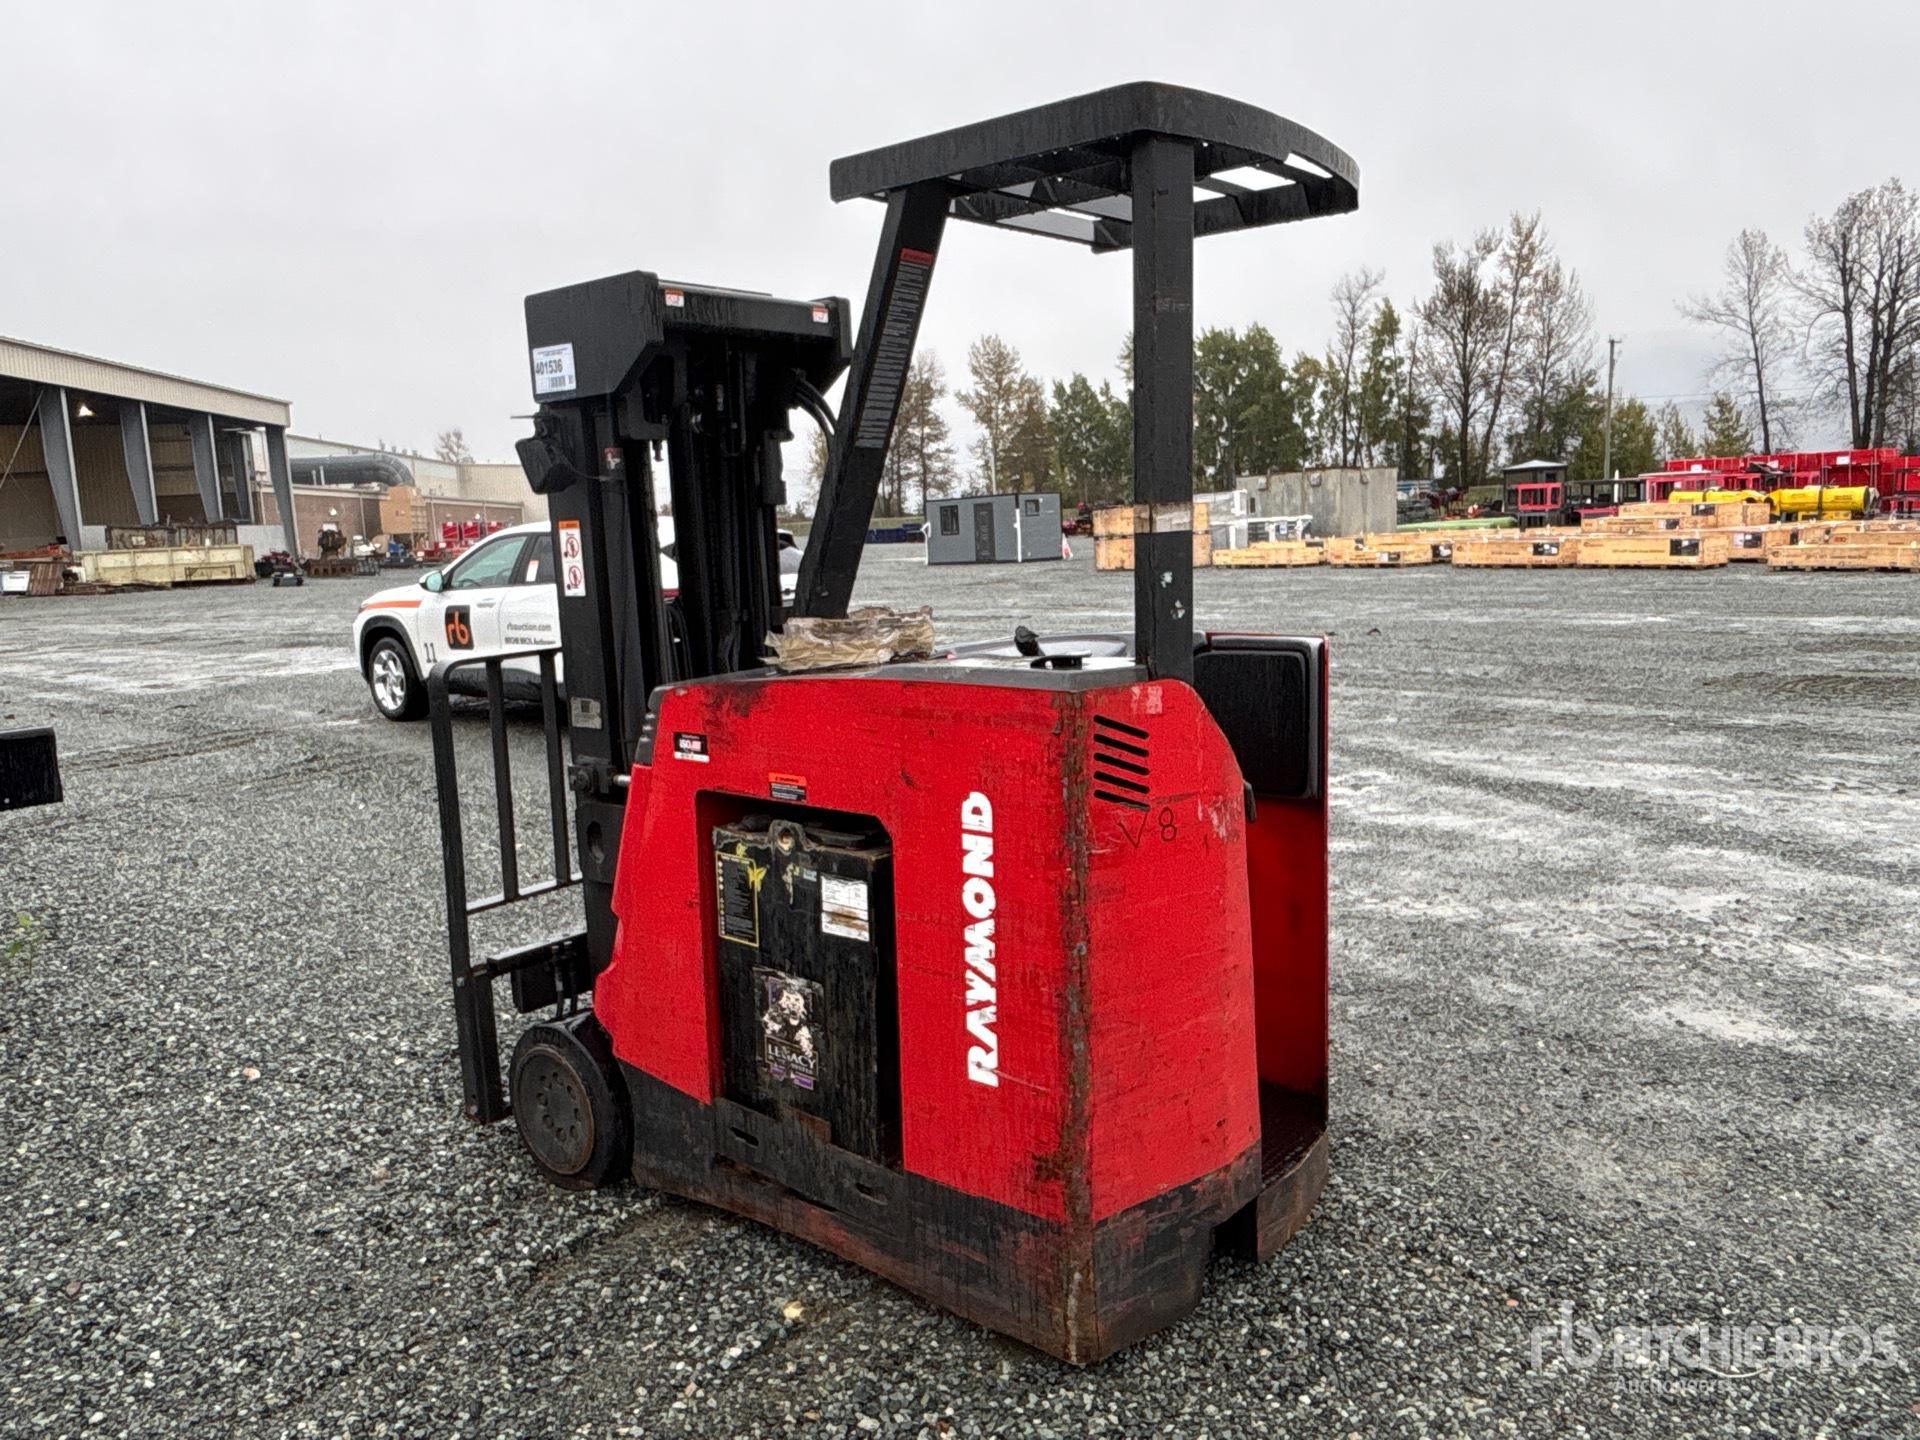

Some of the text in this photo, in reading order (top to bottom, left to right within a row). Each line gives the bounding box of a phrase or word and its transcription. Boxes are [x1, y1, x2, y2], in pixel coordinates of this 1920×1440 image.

[535, 358, 563, 375] 401536
[446, 610, 469, 645] rb
[423, 642, 438, 663] 11
[961, 791, 998, 1088] RAYMOND
